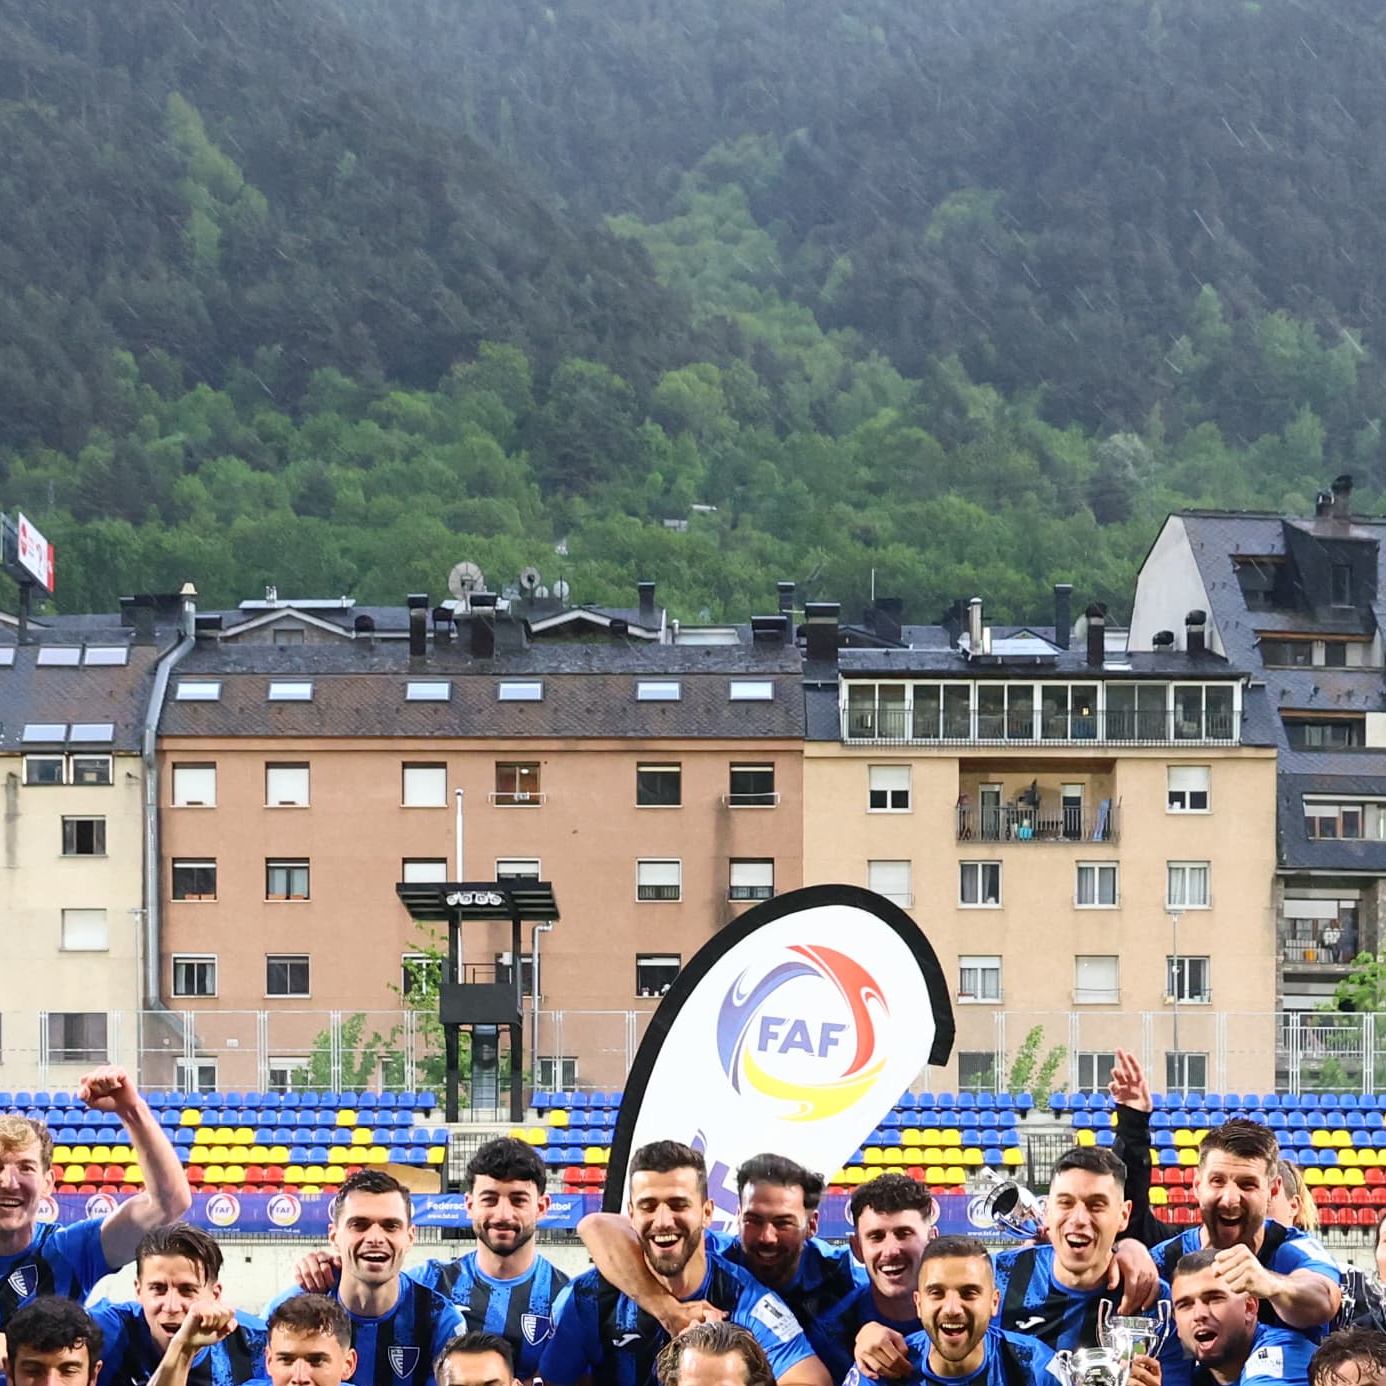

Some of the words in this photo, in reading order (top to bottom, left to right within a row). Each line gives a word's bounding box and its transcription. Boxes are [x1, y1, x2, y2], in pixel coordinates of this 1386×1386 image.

[757, 1016, 849, 1058] FAF
[215, 1206, 230, 1214] FAF
[276, 1206, 291, 1214] FAF
[427, 1202, 465, 1210] Federac
